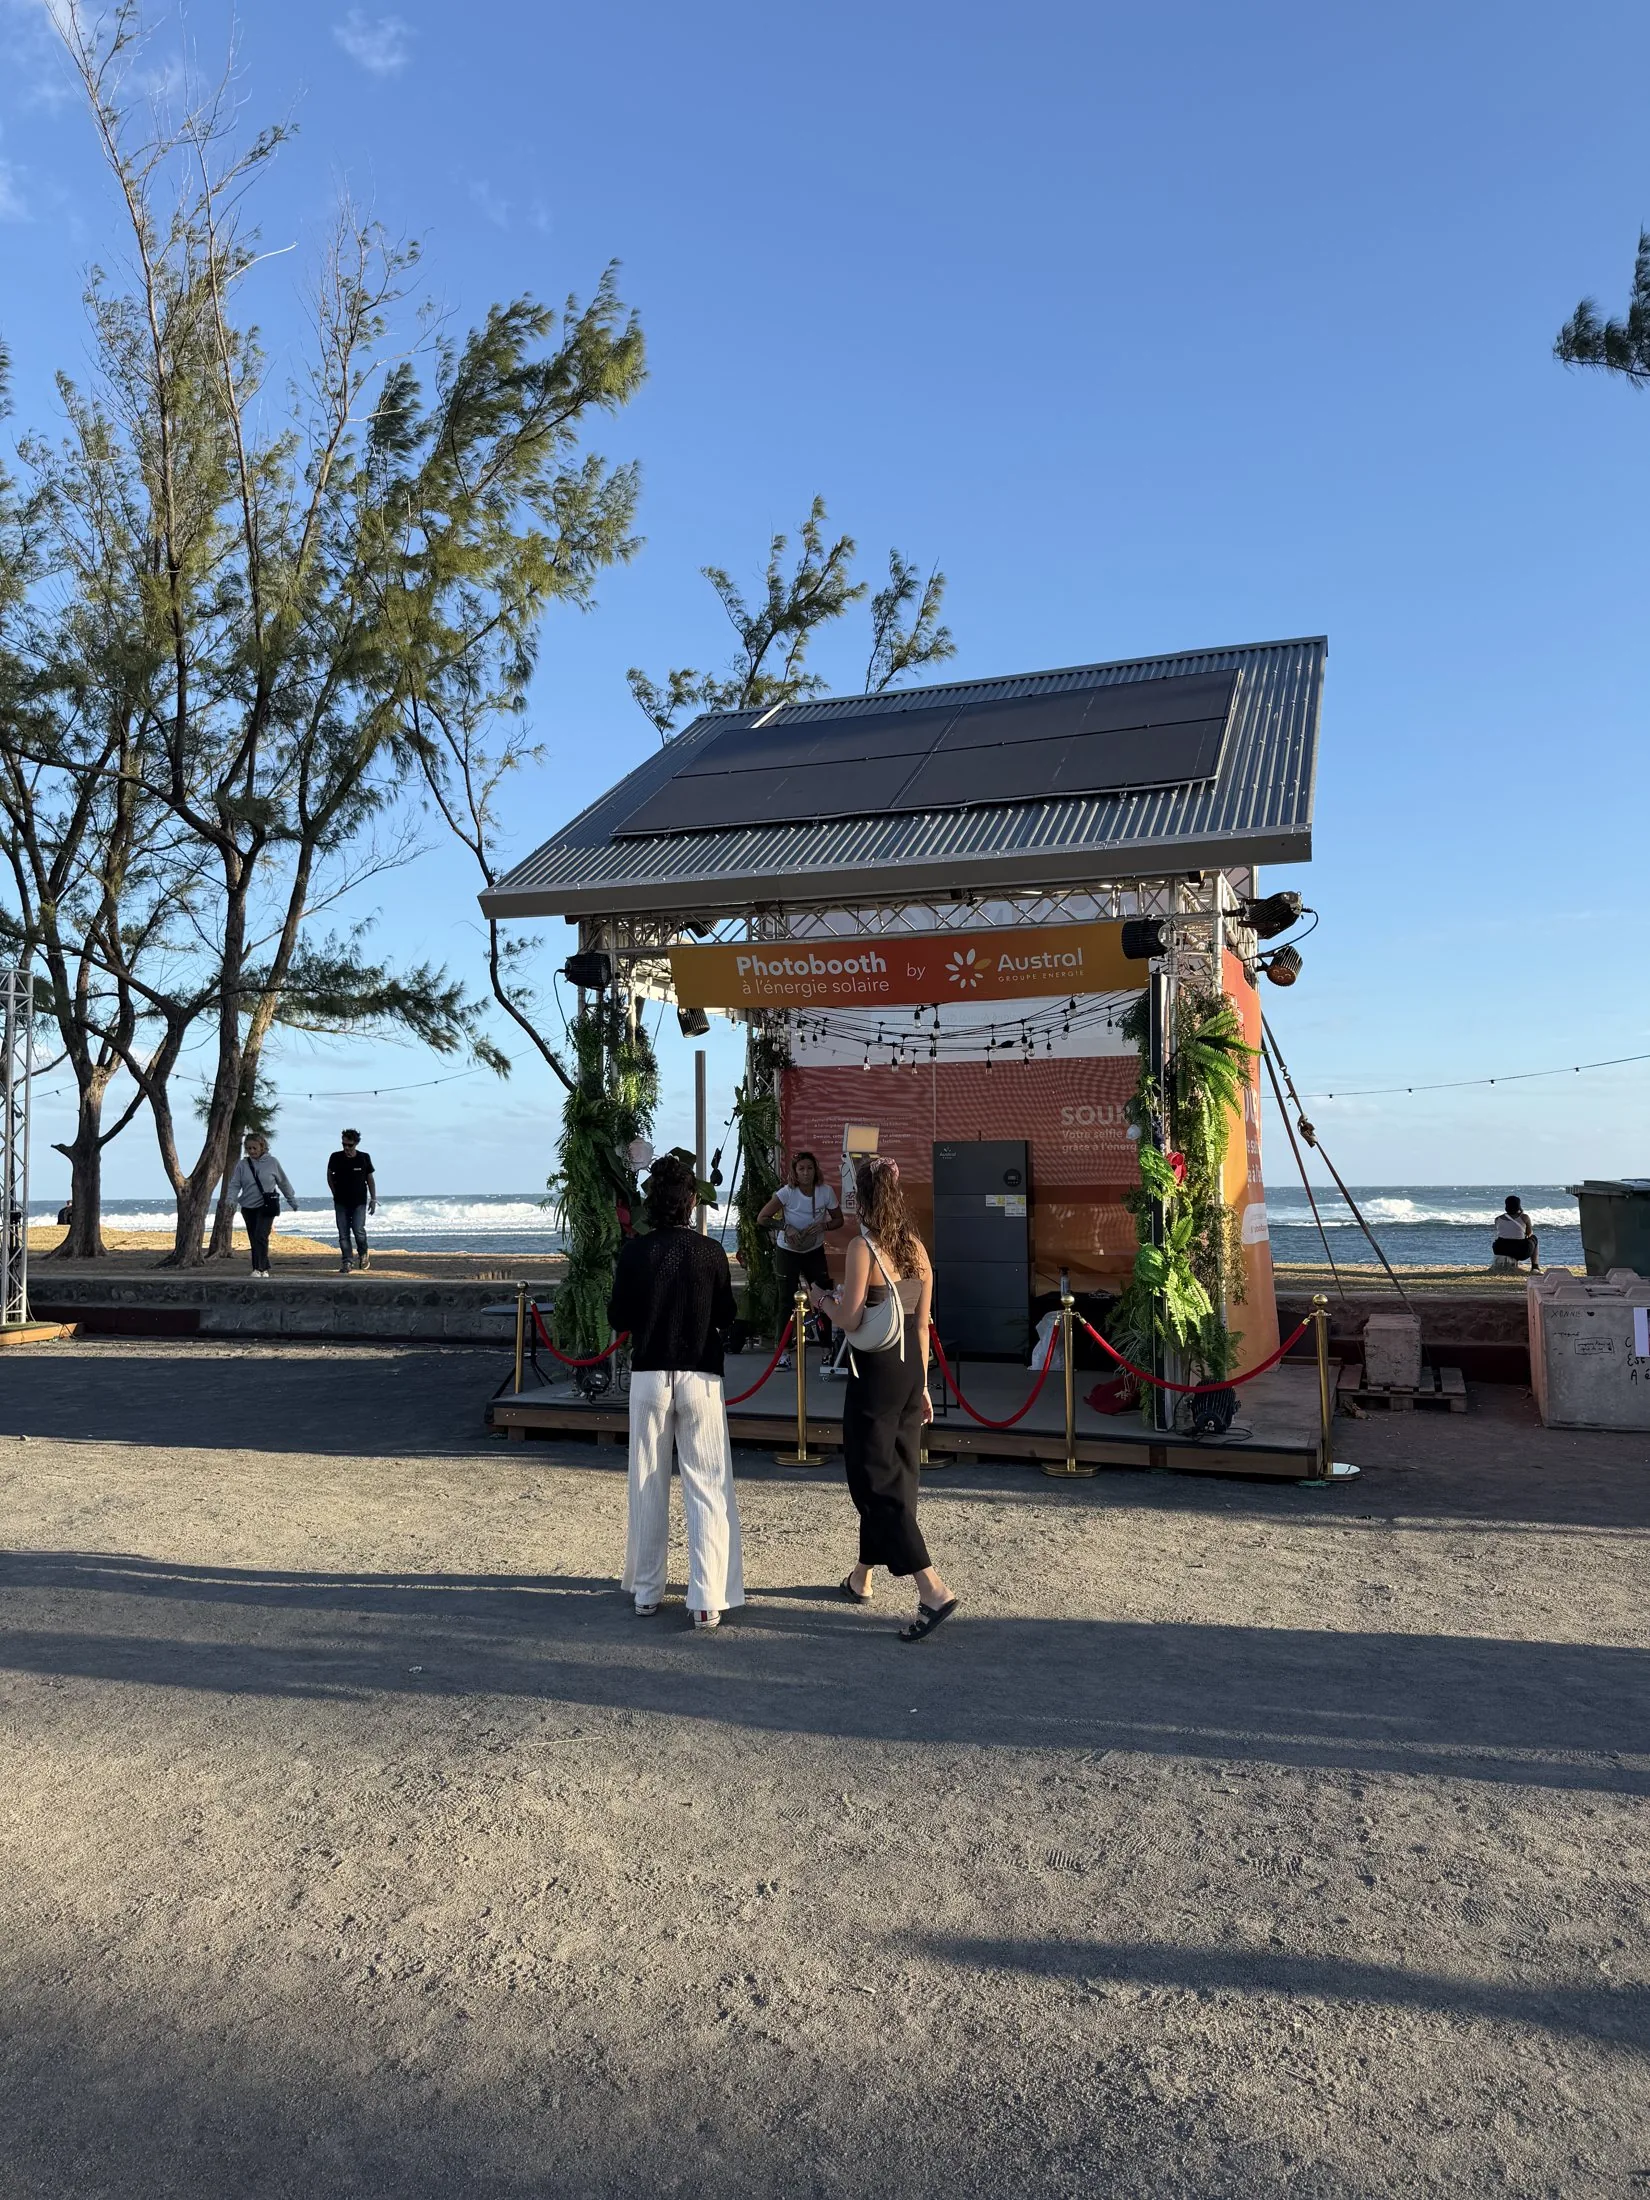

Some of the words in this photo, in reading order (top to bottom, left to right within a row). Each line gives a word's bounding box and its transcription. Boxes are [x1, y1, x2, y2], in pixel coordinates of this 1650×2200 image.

[736, 951, 887, 976] Photobooth
[997, 947, 1083, 972] Austral
[907, 962, 926, 980] by
[998, 974, 1037, 982] GROUPE
[742, 979, 752, 994] à
[755, 978, 827, 998] l'énergie
[832, 977, 890, 993] solaire
[1062, 1130, 1091, 1139] Votre
[1093, 1129, 1123, 1139] selfie
[1062, 1143, 1091, 1154] grâce
